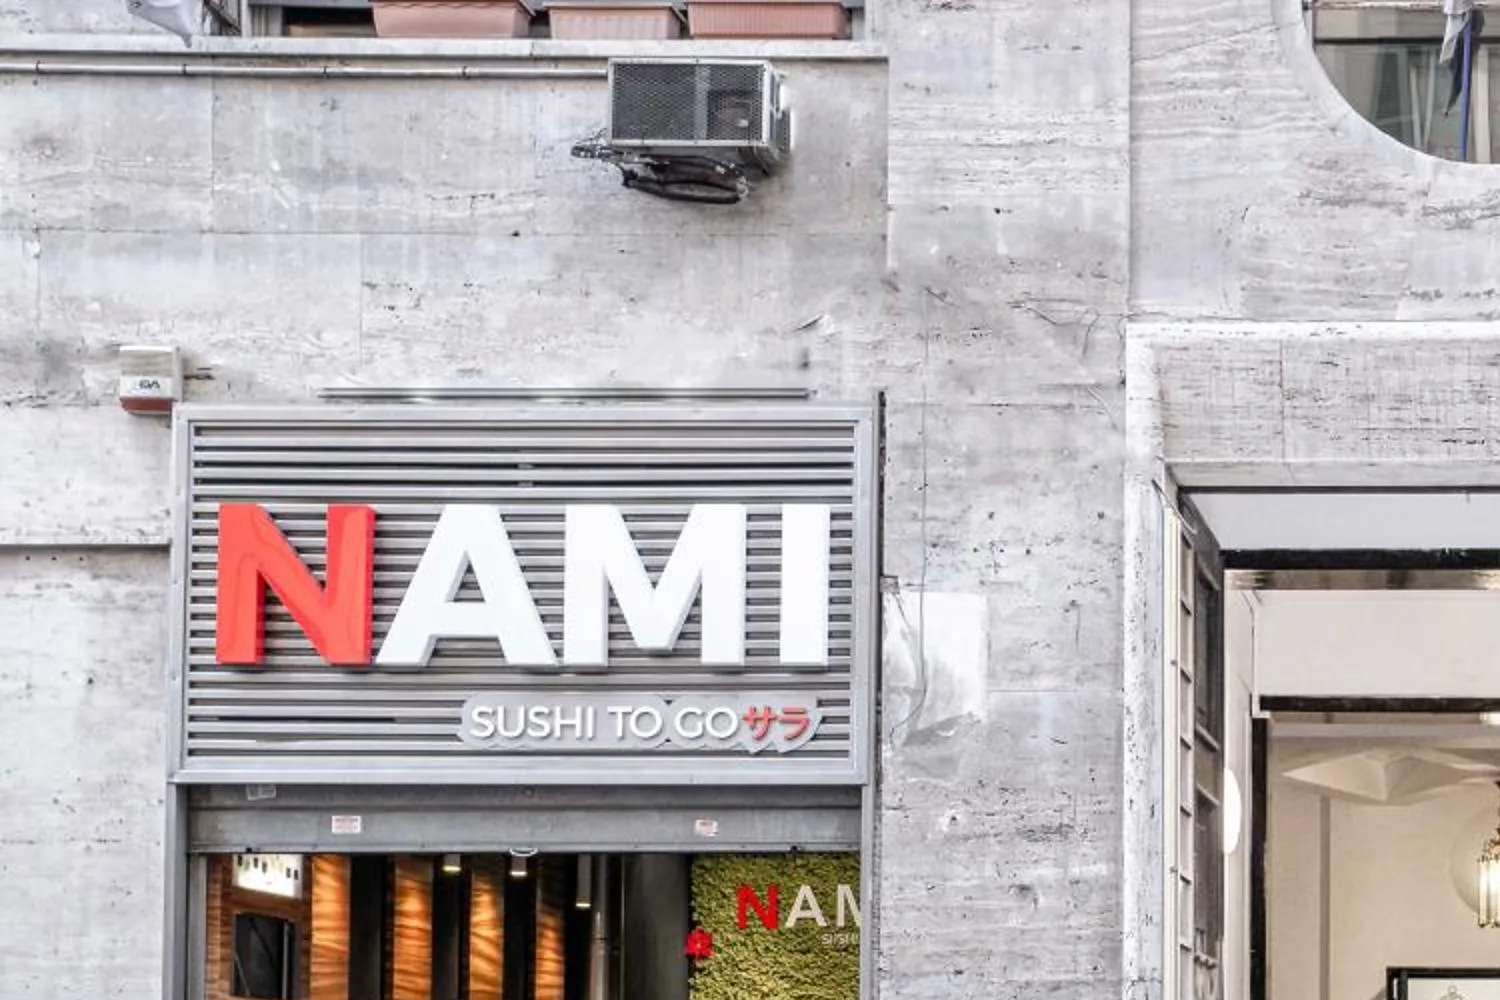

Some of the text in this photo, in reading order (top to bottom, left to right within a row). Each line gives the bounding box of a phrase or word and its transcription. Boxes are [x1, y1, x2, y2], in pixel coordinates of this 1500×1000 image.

[216, 503, 831, 668] NAMI
[469, 705, 738, 740] SUSHI TO GO
[741, 705, 811, 742] サラ
